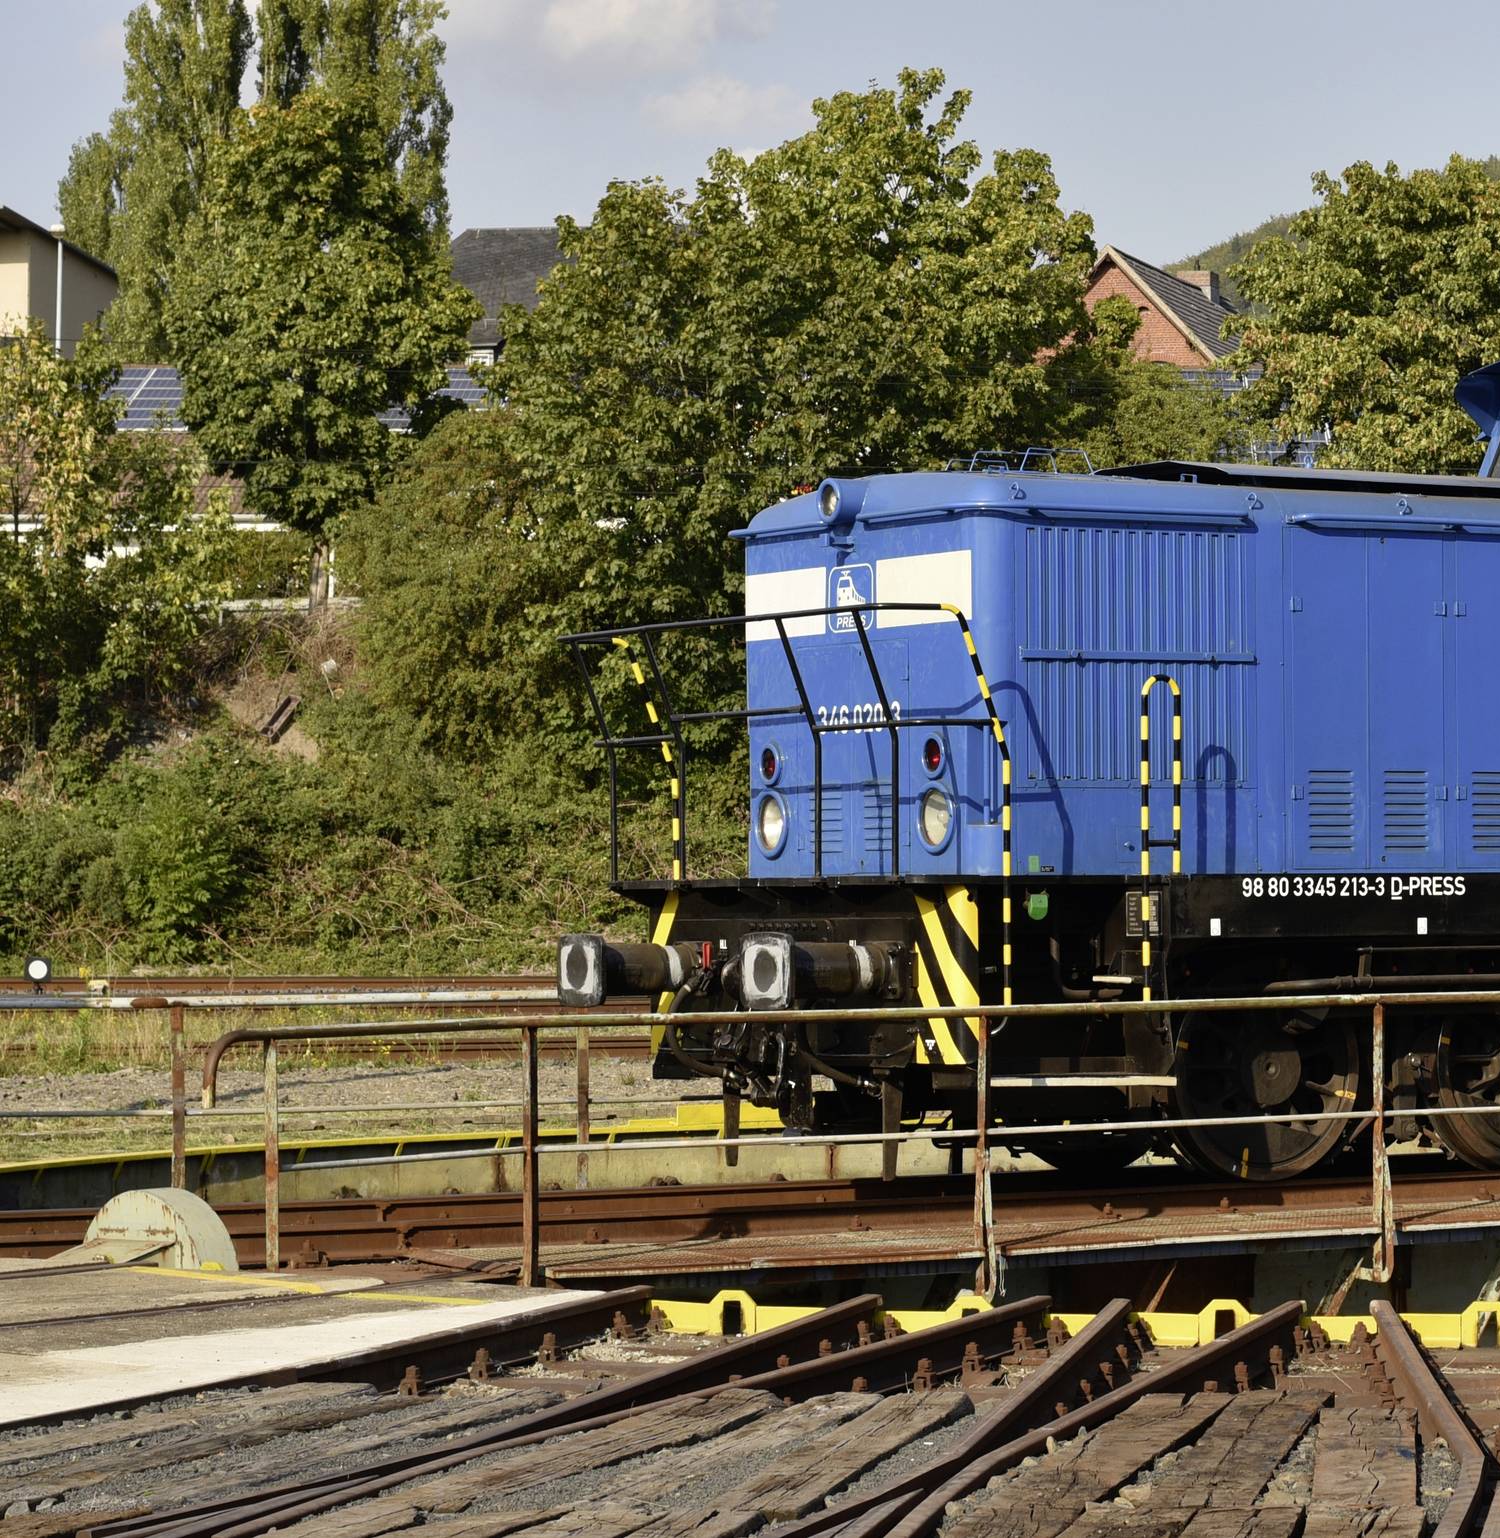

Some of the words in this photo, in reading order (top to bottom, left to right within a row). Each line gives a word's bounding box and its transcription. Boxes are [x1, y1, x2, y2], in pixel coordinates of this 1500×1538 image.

[836, 614, 866, 629] PRES
[818, 705, 849, 735] 346
[1242, 877, 1264, 897] 98
[1268, 877, 1289, 897] 80
[1293, 877, 1336, 897] 3345
[1340, 877, 1385, 897] 213-3
[1391, 876, 1466, 900] D-PRESS
